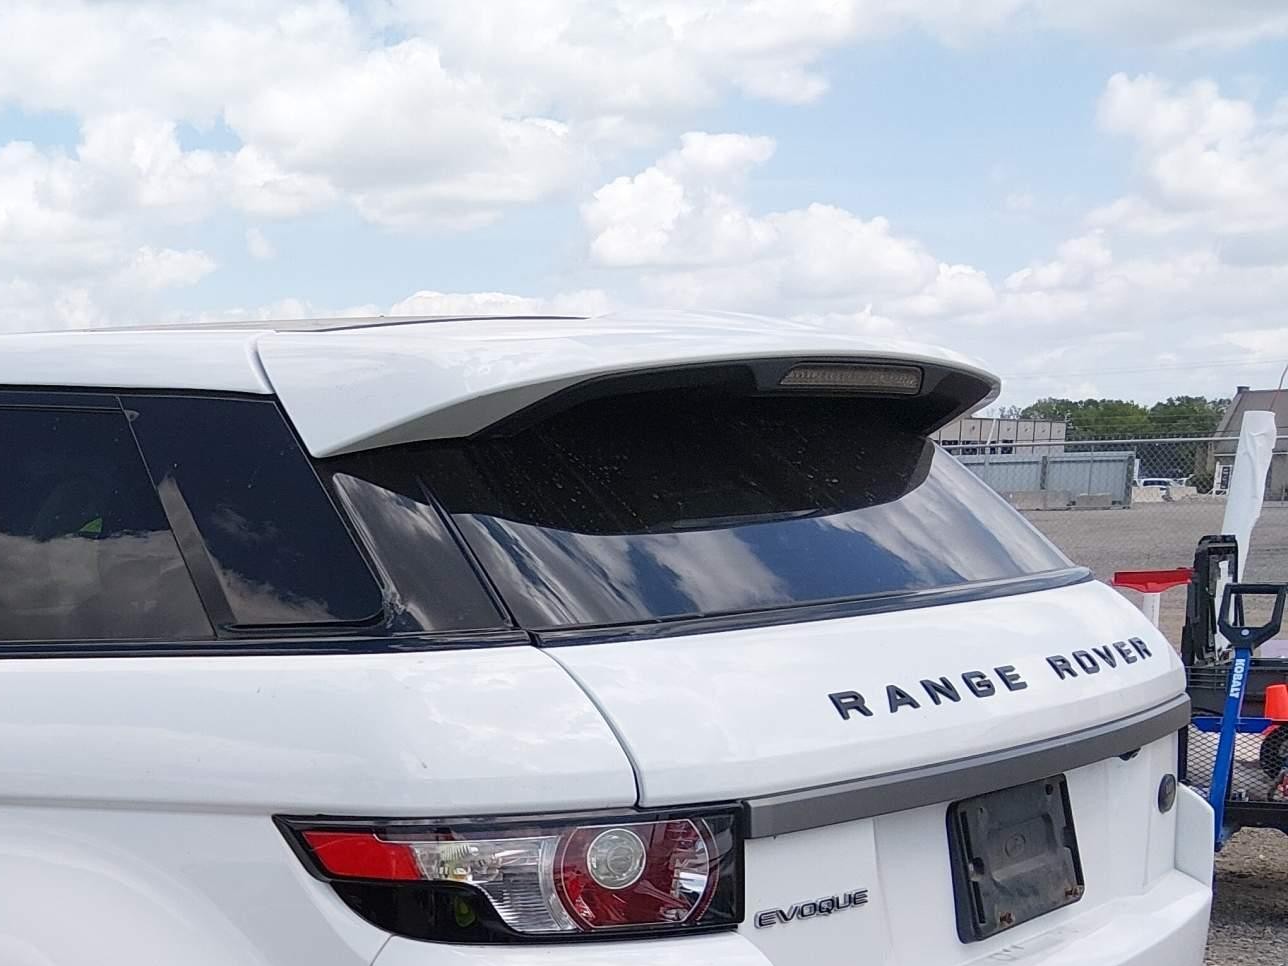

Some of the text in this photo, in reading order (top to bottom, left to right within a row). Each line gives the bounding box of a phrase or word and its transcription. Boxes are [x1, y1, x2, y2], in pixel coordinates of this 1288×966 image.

[827, 636, 1153, 720] RANGE ROVER
[1229, 658, 1246, 699] KOBALT
[754, 889, 869, 929] EVOQUE
